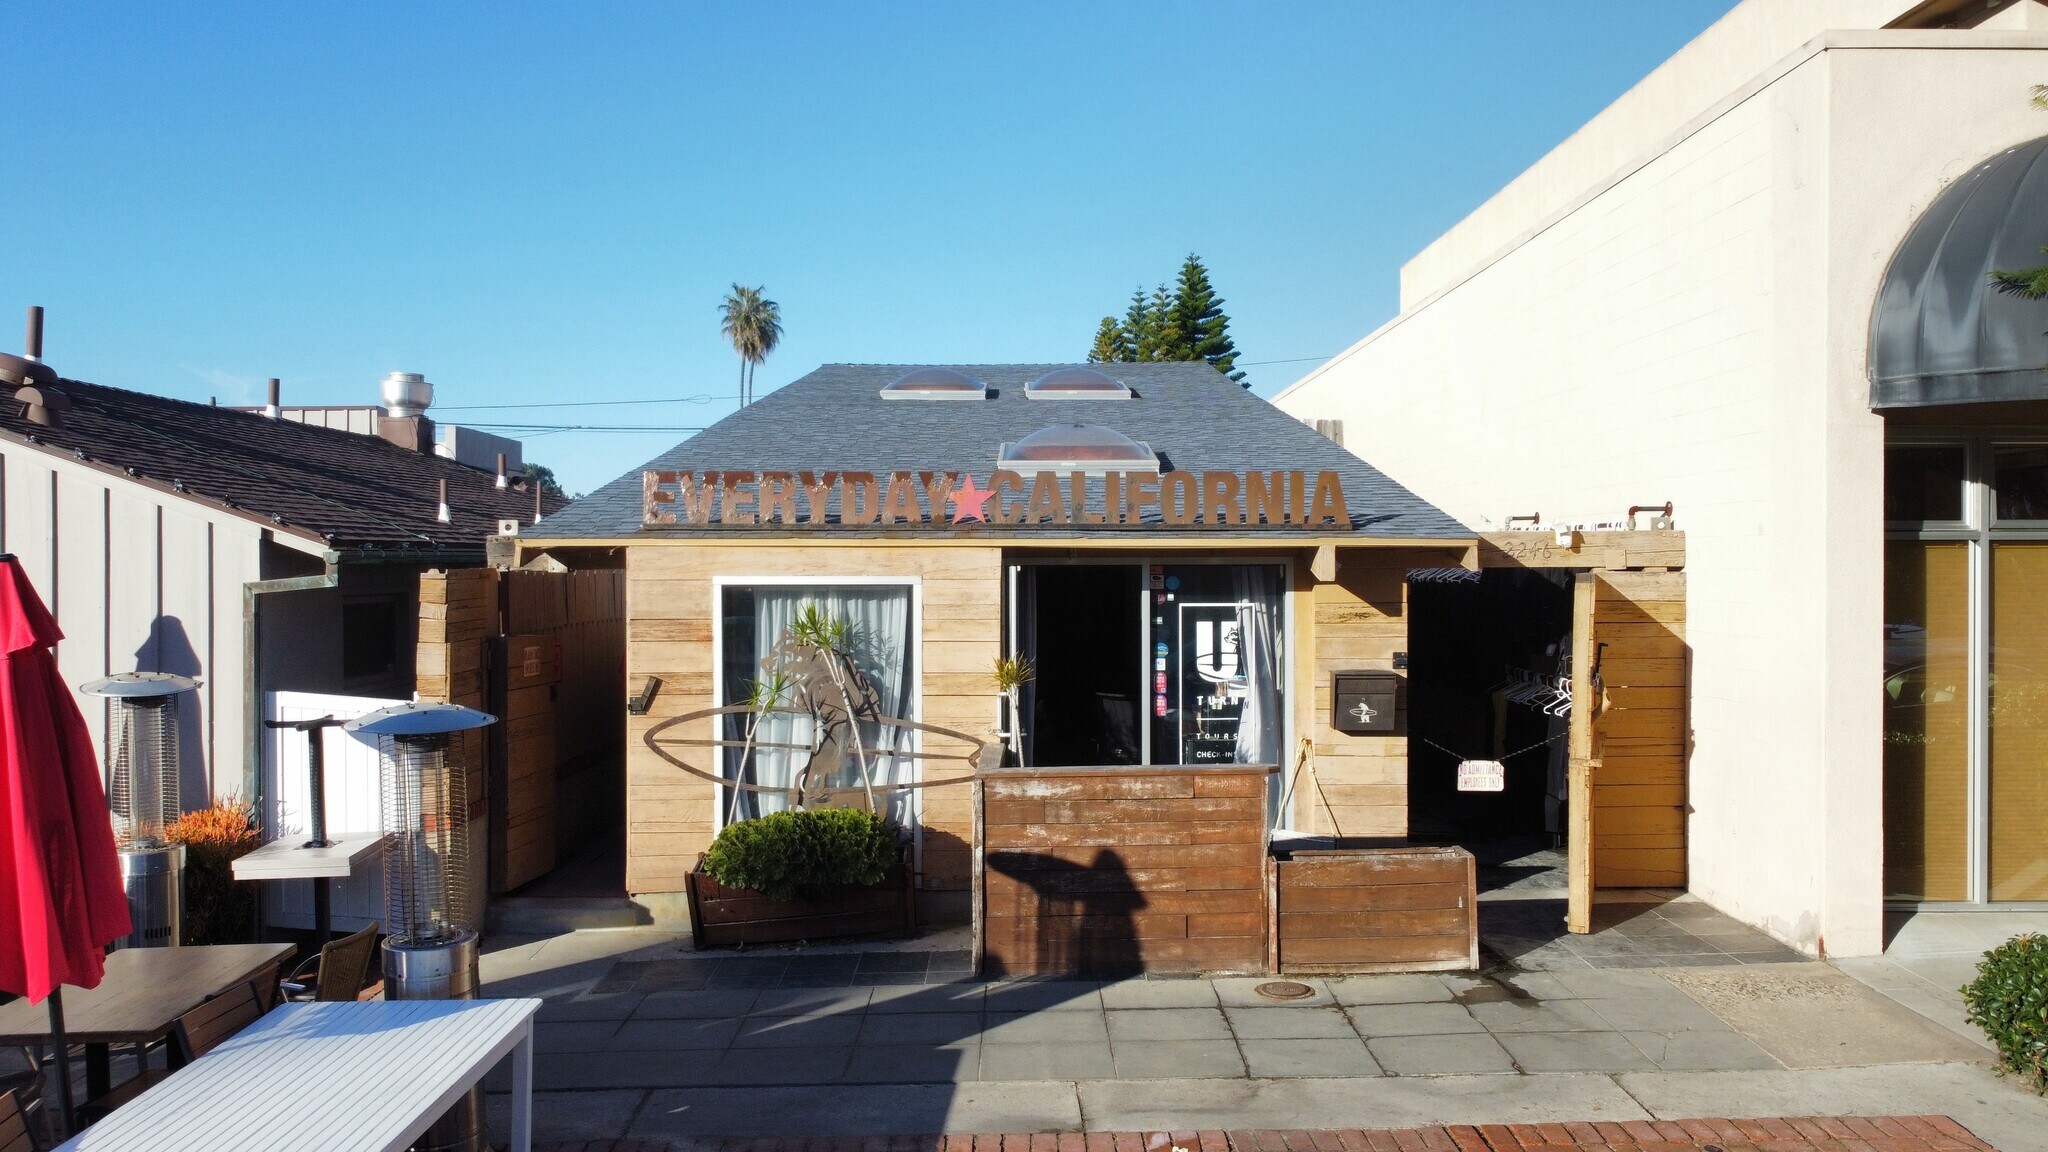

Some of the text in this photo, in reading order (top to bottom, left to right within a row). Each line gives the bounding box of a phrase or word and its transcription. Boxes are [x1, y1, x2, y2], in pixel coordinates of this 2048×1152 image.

[643, 471, 1351, 525] EVERYDAY CALIFORNIA
[1503, 541, 1552, 560] 2246
[1196, 695, 1239, 706] TURN
[1196, 732, 1239, 740] TOURS
